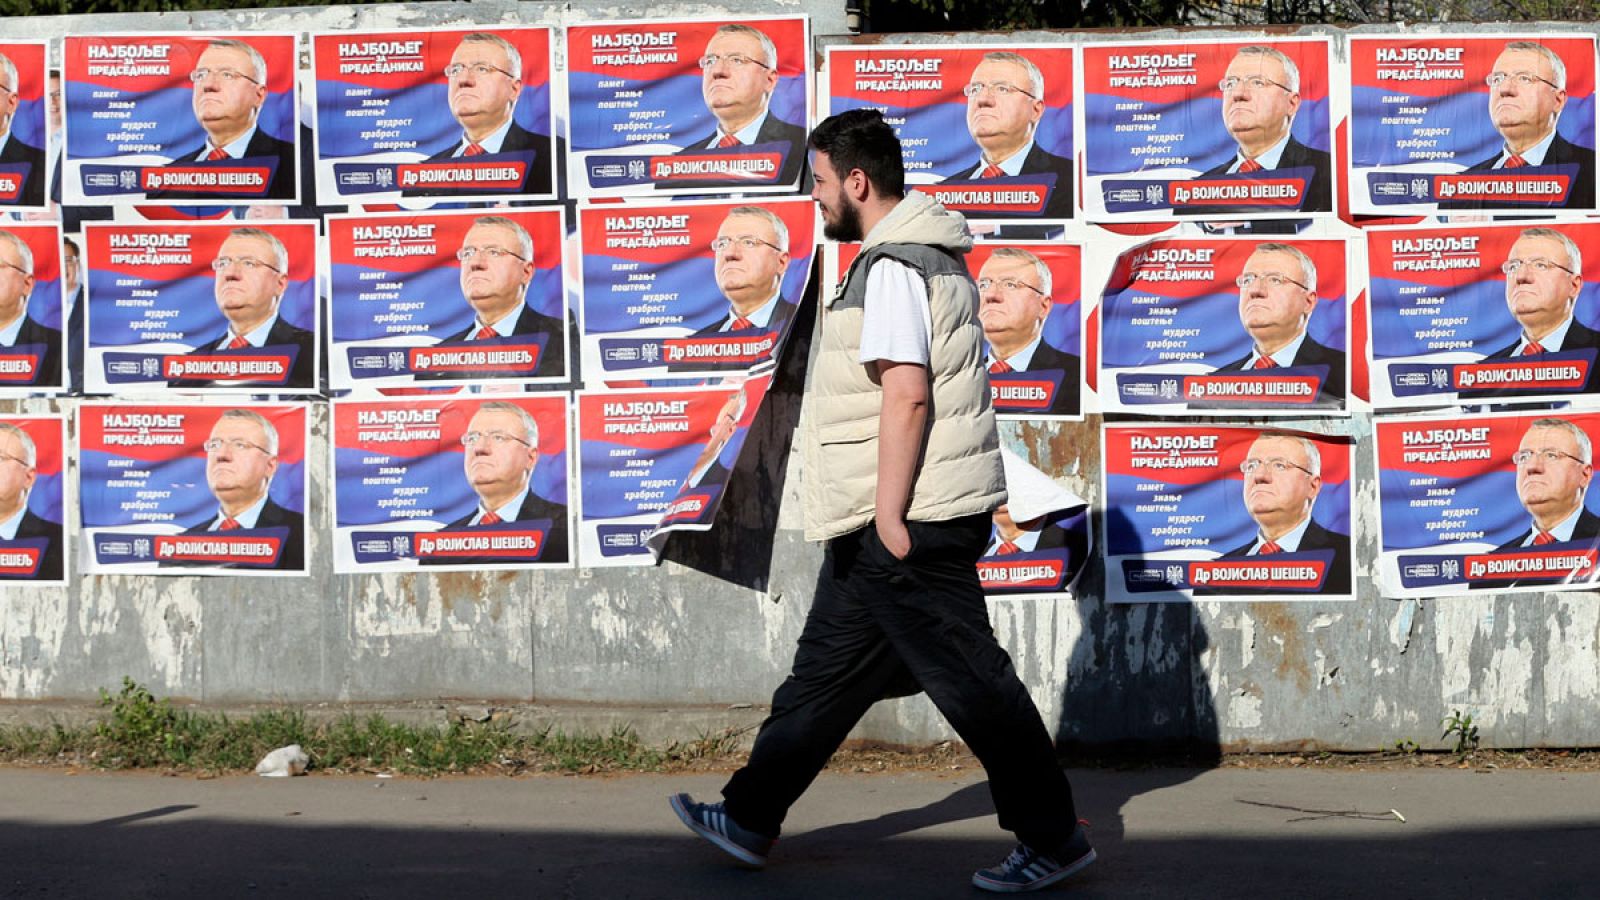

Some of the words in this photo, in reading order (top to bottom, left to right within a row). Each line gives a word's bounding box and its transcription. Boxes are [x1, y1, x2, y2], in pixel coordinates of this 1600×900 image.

[592, 32, 677, 47] НАЈБОЉЕГ
[88, 45, 170, 58] НАЈБОЉЕГ
[339, 41, 422, 56] НАЈБОЉЕГ
[1376, 48, 1463, 61] НАЈБОЉЕГ
[592, 52, 677, 65] ПРЕДСЕДНИКА!
[1109, 54, 1196, 68] НАЈБОЉЕГ
[88, 65, 170, 76] ПРЕДСЕДНИКА!
[340, 61, 423, 74] ПРЕДСЕДНИКА!
[855, 59, 942, 72] НАЈБОЉЕГ
[1110, 75, 1197, 87] ПРЕДСЕДНИКА!
[1376, 69, 1464, 80] ПРЕДСЕДНИКА!
[598, 80, 625, 88] памет
[855, 80, 942, 91] ПРЕДСЕДНИКА!
[1381, 95, 1409, 103] памет
[1115, 102, 1143, 110] памет
[656, 162, 671, 177] Др
[674, 160, 728, 174] ВОЈИСЛАВ
[730, 158, 775, 172] ШЕШЕЉ
[164, 172, 216, 185] ВОЈИСЛАВ
[219, 173, 263, 185] ШЕШЕЉ
[420, 168, 473, 182] ВОЈИСЛАВ
[475, 167, 520, 180] ШЕШЕЉ
[1175, 187, 1190, 203] Др
[1193, 185, 1249, 199] ВОЈИСЛАВ
[1251, 184, 1297, 198] ШЕШЕЉ
[1440, 181, 1456, 197] Др
[1458, 181, 1514, 194] ВОЈИСЛАВ
[1516, 181, 1562, 194] ШЕШЕЉ
[936, 191, 991, 204] ВОЈИСЛАВ
[993, 191, 1040, 204] ШЕШЕЉ
[606, 215, 689, 230] НАЈБОЉЕГ
[353, 224, 435, 239] НАЈБОЉЕГ
[110, 234, 191, 246] НАЈБОЉЕГ
[606, 235, 690, 248] ПРЕДСЕДНИКА!
[1392, 236, 1479, 252] НАЈБОЉЕГ
[354, 245, 436, 257] ПРЕДСЕДНИКА!
[111, 254, 192, 265] ПРЕДСЕДНИКА!
[1393, 257, 1480, 271] ПРЕДСЕДНИКА!
[1399, 286, 1427, 294] памет
[433, 351, 486, 365] ВОЈИСЛАВ
[488, 350, 532, 364] ШЕШЕЉ
[669, 345, 684, 360] Др
[687, 342, 741, 357] ВОЈИСЛАВ
[0, 359, 32, 373] ЕШЕЉ
[186, 361, 238, 373] ВОЈИСЛАВ
[240, 361, 283, 373] ШЕШЕЉ
[1460, 370, 1475, 386] Др
[1477, 368, 1533, 382] ВОЈИСЛАВ
[1535, 366, 1581, 380] ШЕШЕЉ
[1001, 387, 1047, 399] ШЕШЕЉ
[1189, 382, 1205, 398] Др
[1207, 382, 1263, 394] ВОЈИСЛАВ
[1265, 382, 1312, 395] ШЕШЕЉ
[604, 401, 688, 415] НАЈБОЉЕГ
[103, 415, 184, 427] НАЈБОЉЕГ
[358, 409, 440, 423] НАЈБОЉЕГ
[605, 421, 689, 434] ПРЕДСЕДНИКА!
[104, 434, 184, 445] ПРЕДСЕДНИКА!
[358, 429, 440, 442] ПРЕДСЕДНИКА!
[1131, 435, 1218, 449] НАЈБОЉЕГ
[1403, 427, 1490, 444] НАЈБОЉЕГ
[610, 448, 637, 456] памет
[1404, 448, 1491, 462] ПРЕДСЕДНИКА!
[1131, 456, 1218, 468] ПРЕДСЕДНИКА!
[1410, 477, 1437, 486] памет
[177, 542, 228, 554] ВОЈИСЛАВ
[230, 543, 273, 554] ШЕШЕЉ
[437, 537, 490, 550] ВОЈИСЛАВ
[492, 536, 536, 549] ШЕШЕЉ
[0, 553, 33, 567] ЕШЕЉ
[1470, 561, 1486, 576] Др
[1488, 557, 1543, 573] ВОЈИСЛАВ
[978, 567, 1007, 580] СЛАВ
[1195, 568, 1210, 583] Др
[1213, 567, 1268, 580] ВОЈИСЛАВ
[1271, 567, 1317, 580] ШЕШЕЉ
